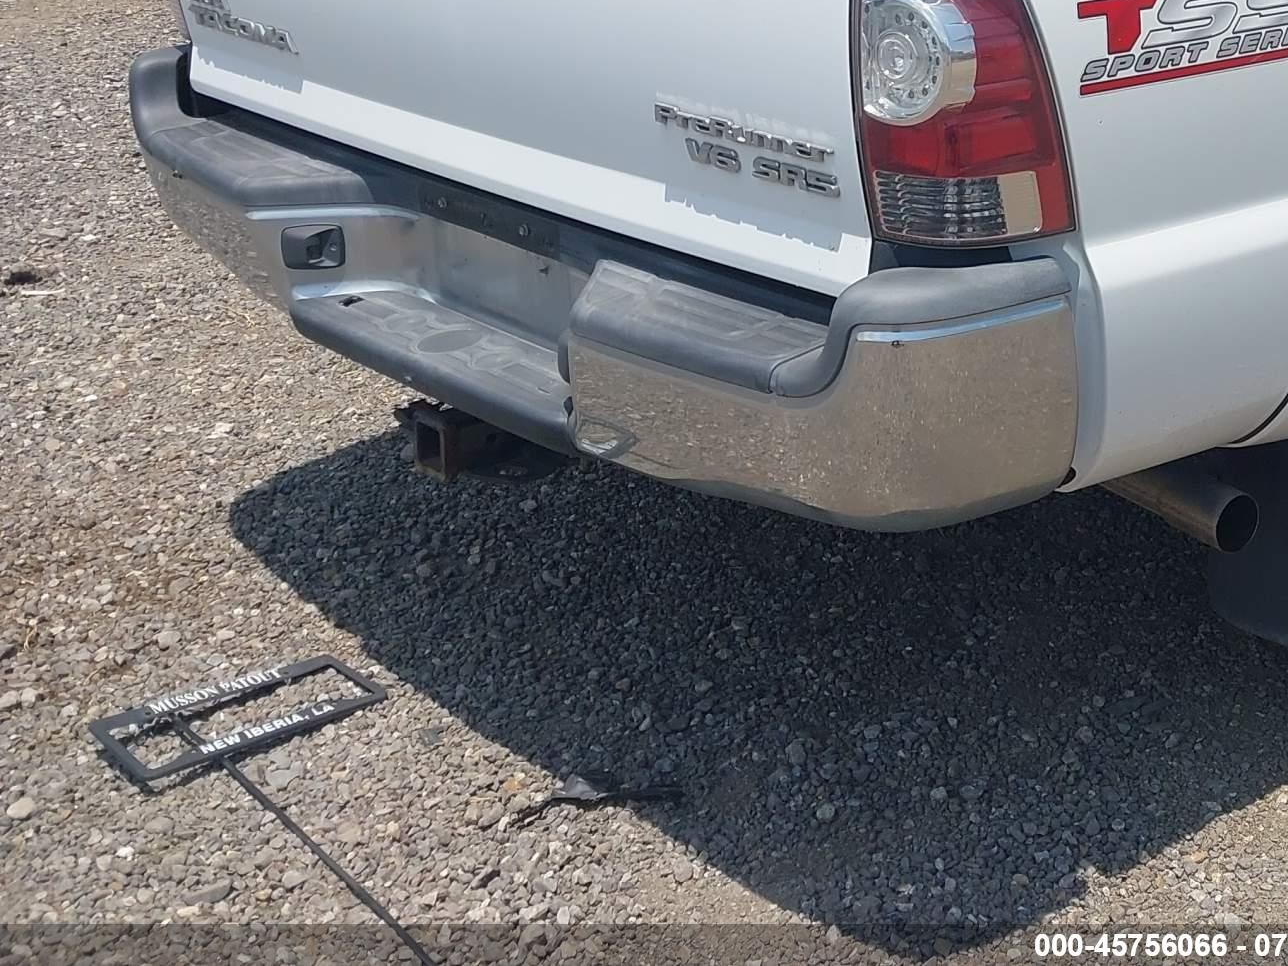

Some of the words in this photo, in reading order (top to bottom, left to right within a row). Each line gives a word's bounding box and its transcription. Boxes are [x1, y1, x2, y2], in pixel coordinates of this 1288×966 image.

[188, 3, 299, 55] TACOMA
[1080, 41, 1209, 82] SPORT
[654, 101, 835, 163] PreRunner
[685, 137, 741, 174] V6
[752, 155, 841, 198] SR5
[150, 685, 221, 715] MUSSON
[220, 667, 282, 693] PATOUT
[201, 734, 241, 755] NEW
[311, 704, 335, 716] LA
